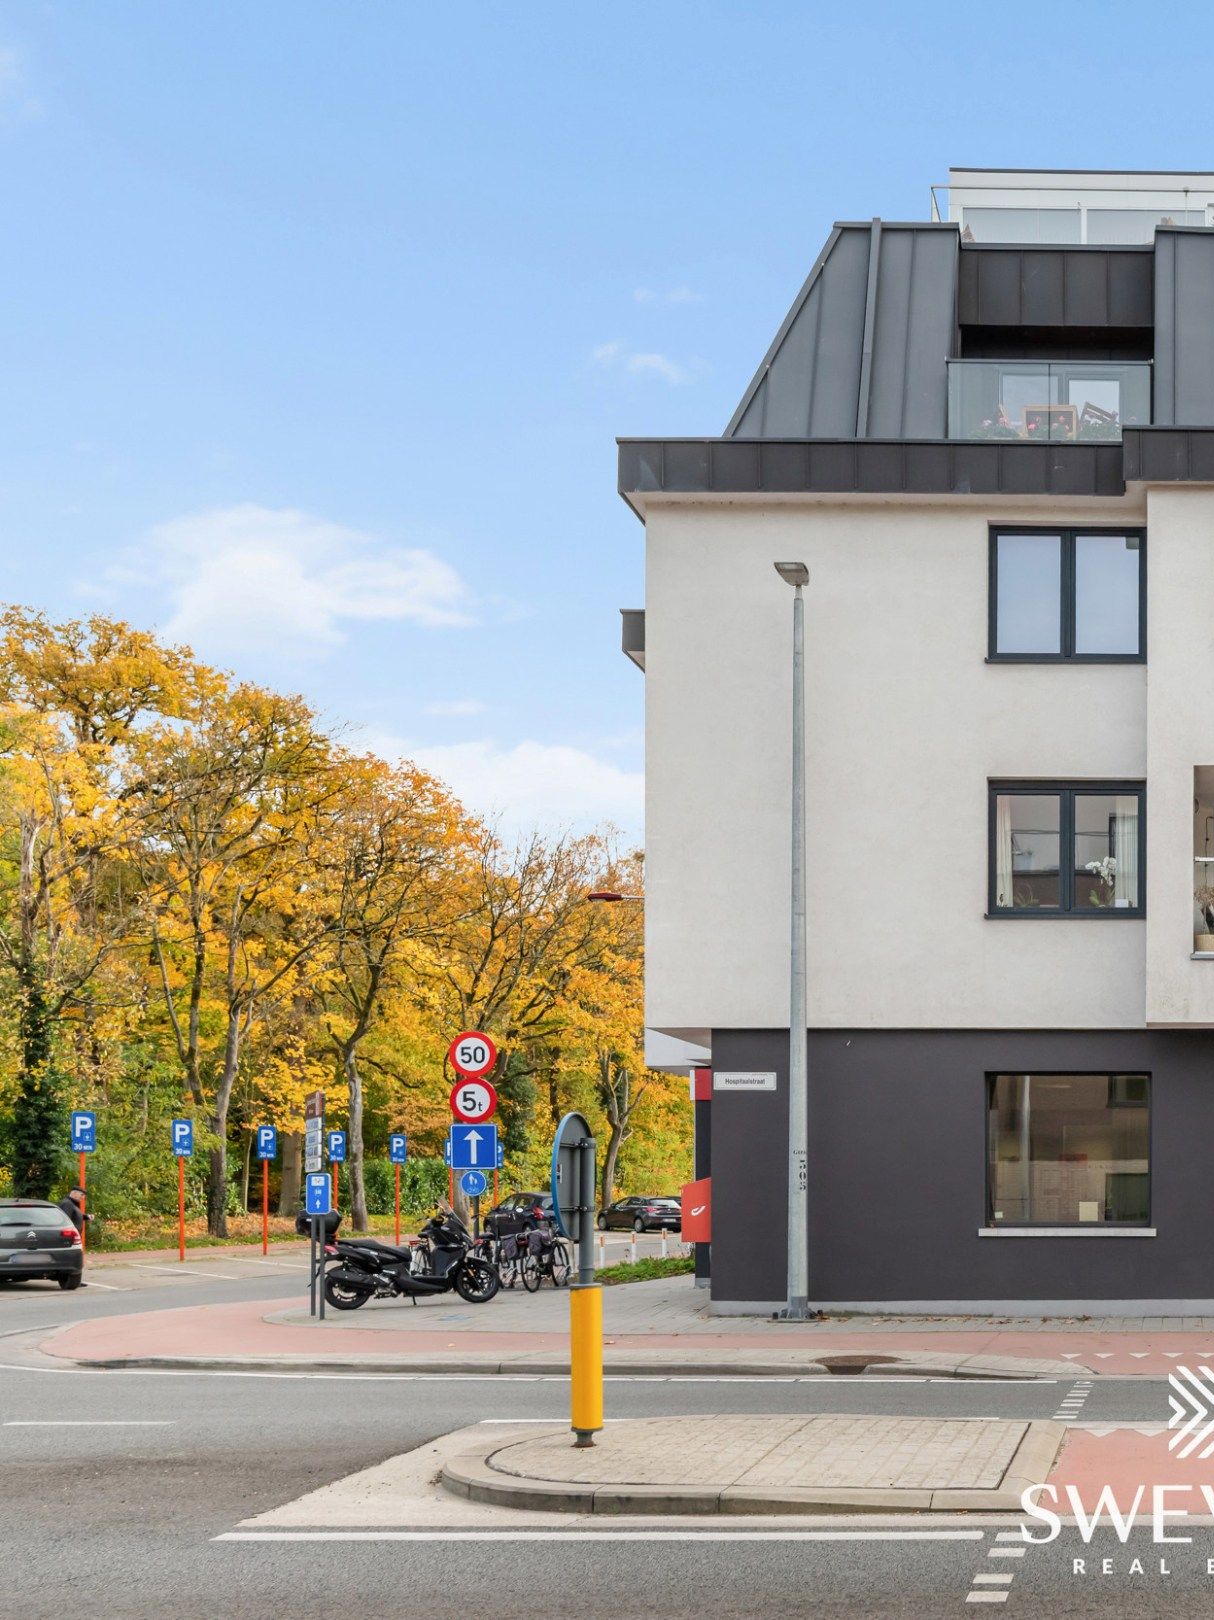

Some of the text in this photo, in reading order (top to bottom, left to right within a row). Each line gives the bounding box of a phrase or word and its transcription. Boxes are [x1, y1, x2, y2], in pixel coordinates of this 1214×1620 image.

[460, 1046, 485, 1064] 50
[725, 1078, 766, 1086] Hospitaalstraat
[75, 1116, 92, 1138] P
[175, 1123, 190, 1143] P
[260, 1129, 274, 1148] P
[330, 1134, 344, 1151] P
[392, 1137, 404, 1153] P
